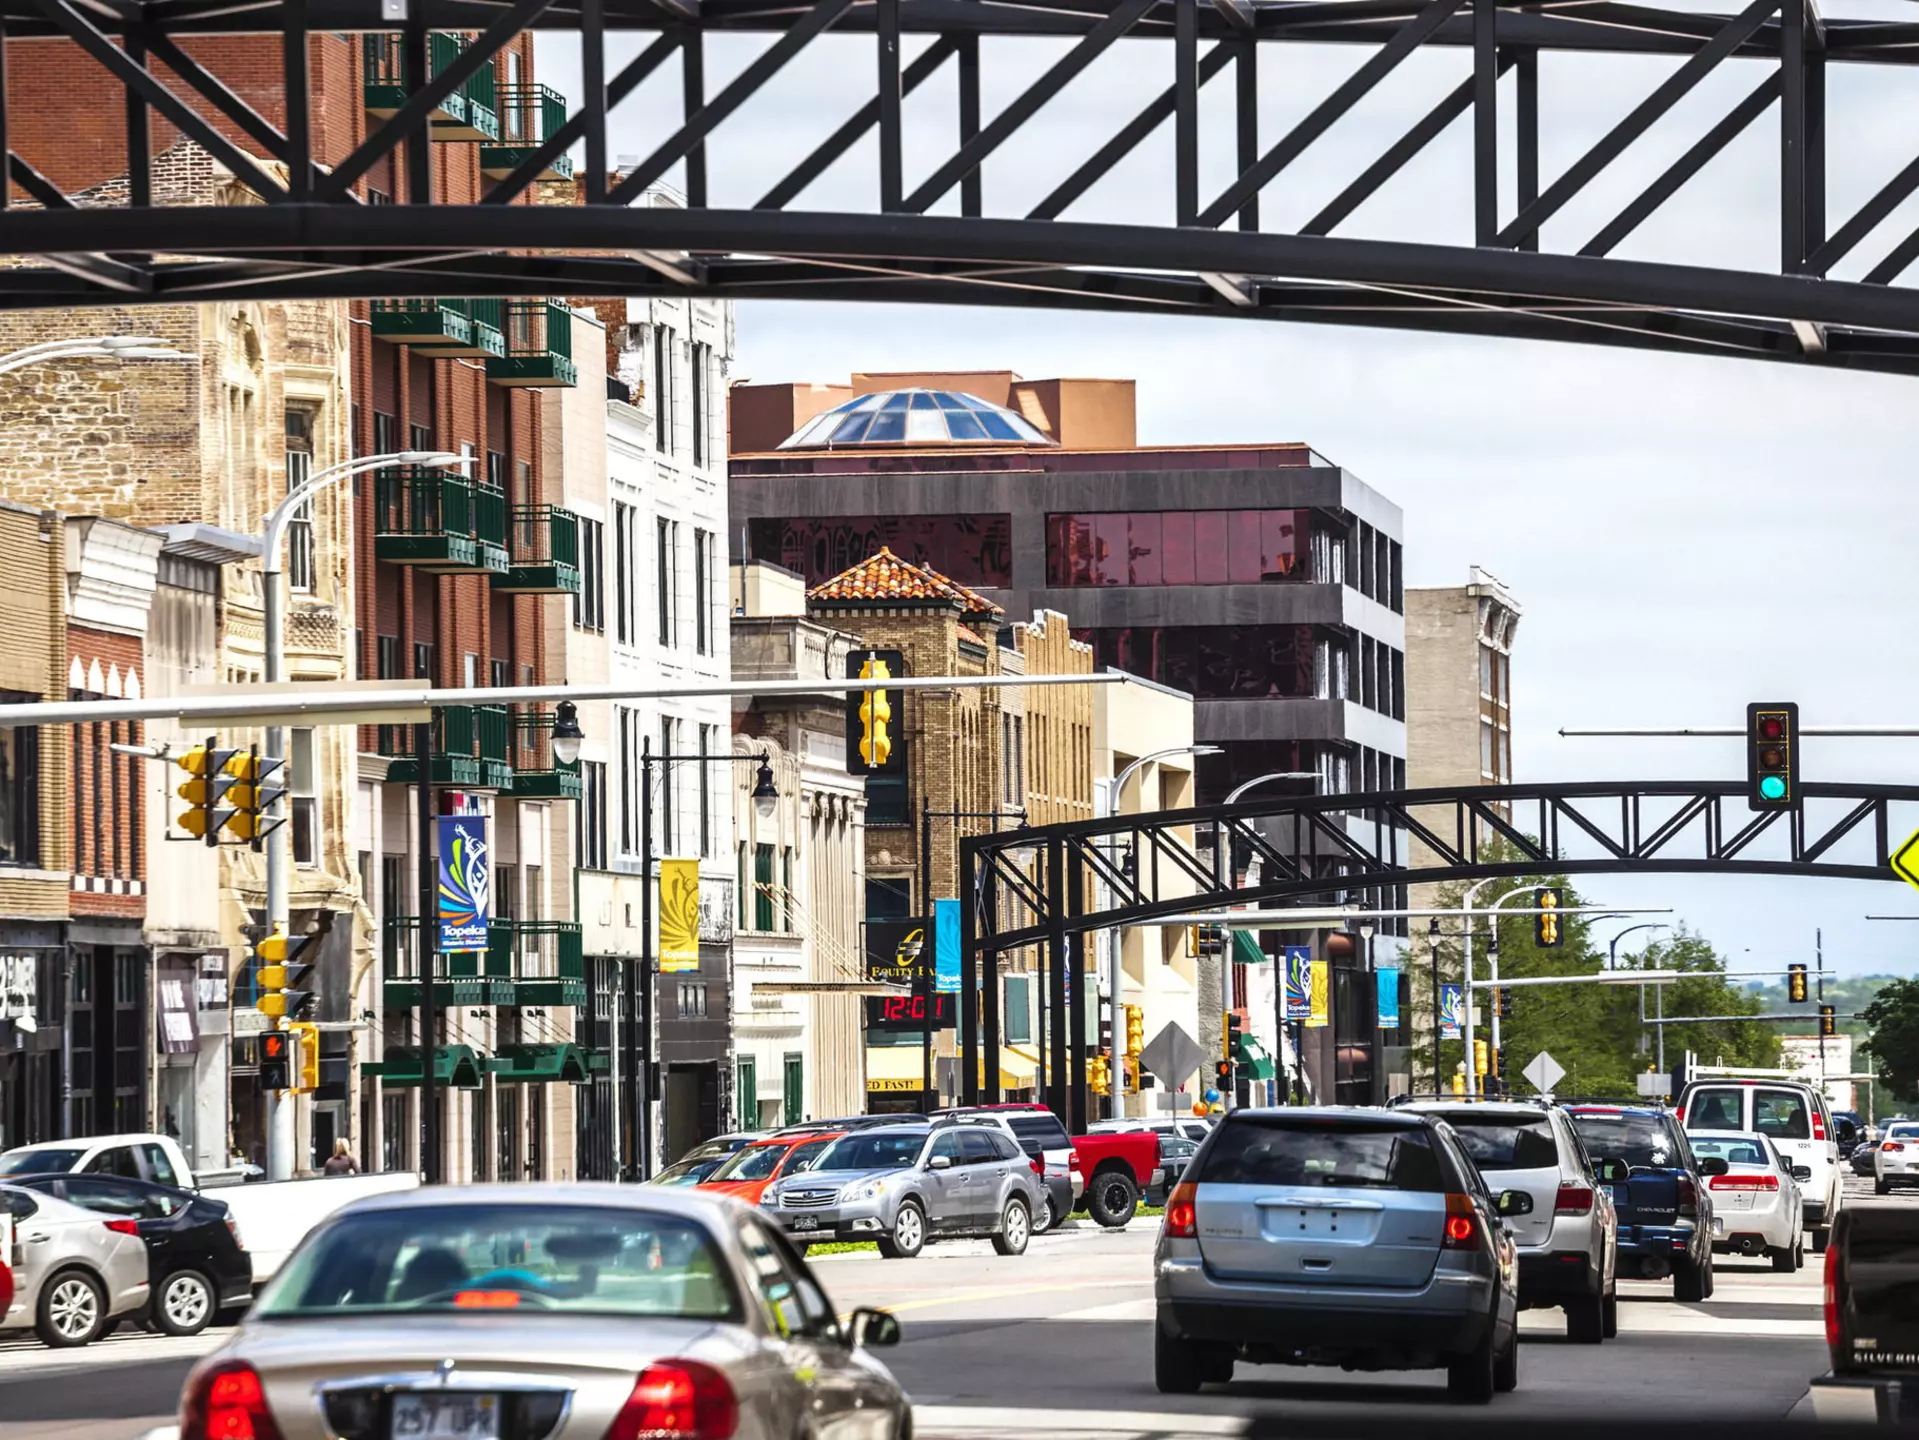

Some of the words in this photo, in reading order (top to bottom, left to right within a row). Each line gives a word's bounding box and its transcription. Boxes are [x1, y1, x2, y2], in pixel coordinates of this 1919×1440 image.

[441, 924, 487, 938] Topeka
[884, 995, 943, 1020] 12:01
[885, 1080, 914, 1089] FAST!
[1636, 1206, 1676, 1214] CHEVROLET
